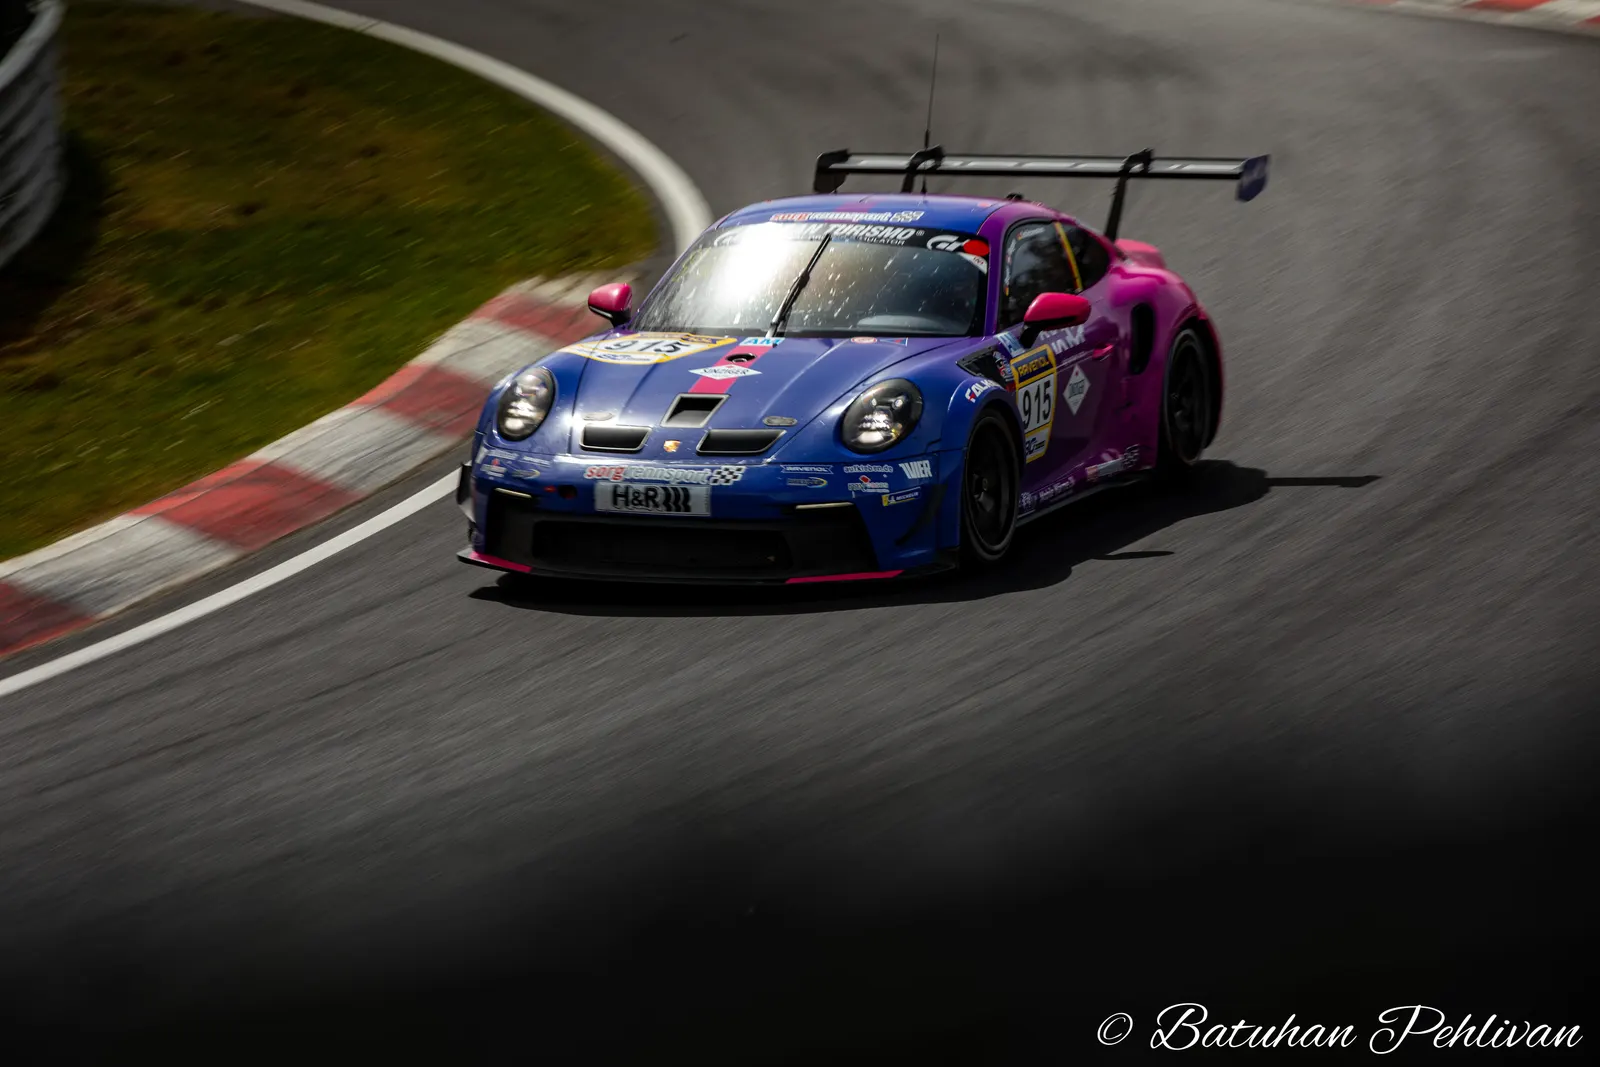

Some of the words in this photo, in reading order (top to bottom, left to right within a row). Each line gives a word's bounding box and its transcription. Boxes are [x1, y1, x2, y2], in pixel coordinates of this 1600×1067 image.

[604, 340, 691, 353] 915
[1017, 357, 1050, 377] RAVENOL
[1022, 380, 1051, 430] 915
[611, 485, 660, 508] H&R
